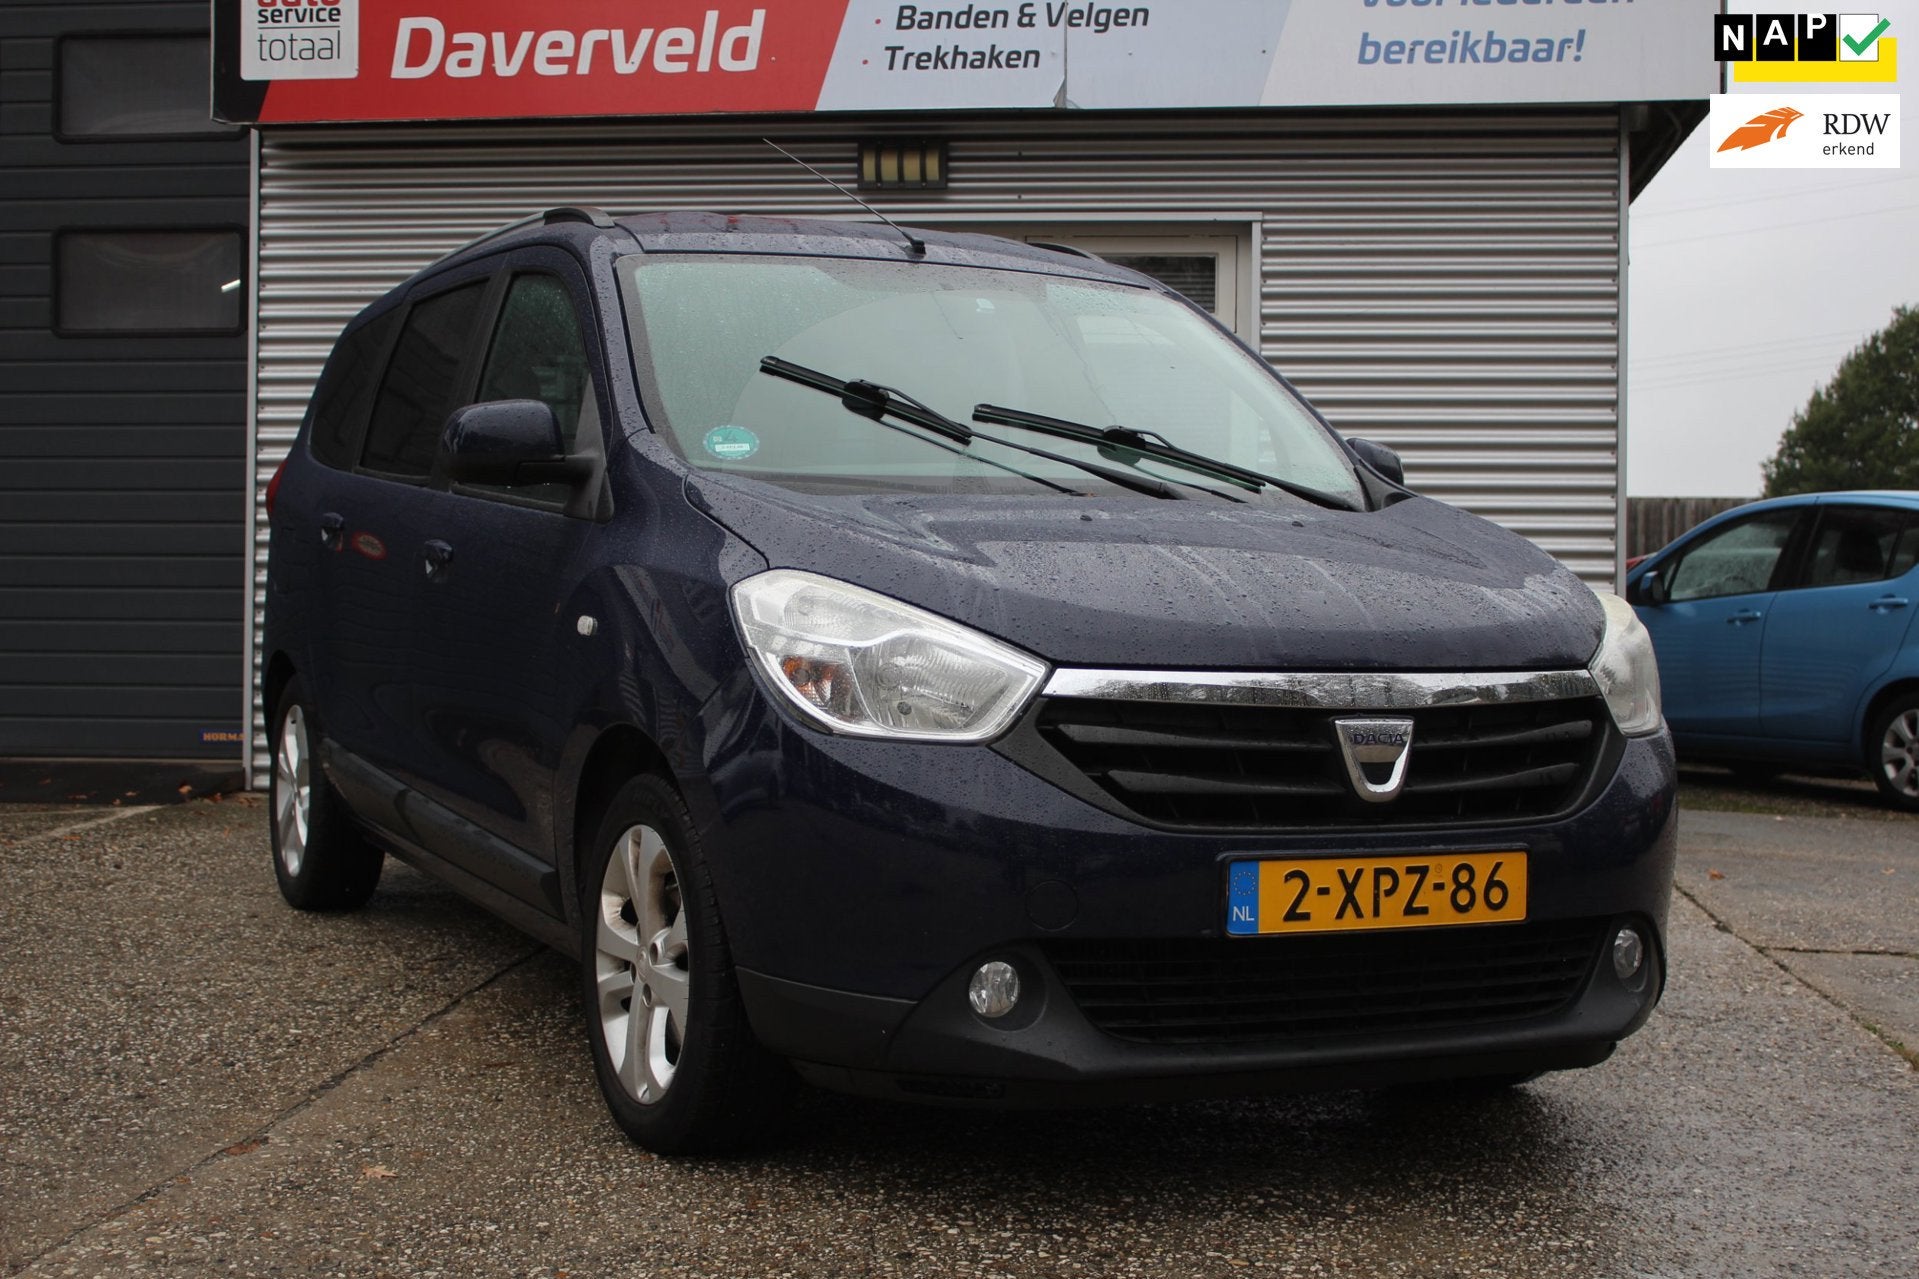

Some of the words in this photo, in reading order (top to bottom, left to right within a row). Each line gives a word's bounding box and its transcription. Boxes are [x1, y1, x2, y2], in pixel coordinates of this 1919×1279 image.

[257, 7, 341, 23] service
[895, 4, 1009, 30] Banden
[1017, 3, 1036, 28] &
[1046, 2, 1150, 33] Velgen
[257, 30, 341, 61] totaal
[391, 9, 766, 79] Daverveld
[884, 44, 1041, 71] Trekhaken
[1357, 29, 1586, 65] bereikbaar!
[1353, 733, 1405, 745] DACIA
[1282, 861, 1509, 923] 2-XPZ-86
[1232, 905, 1255, 921] NL
